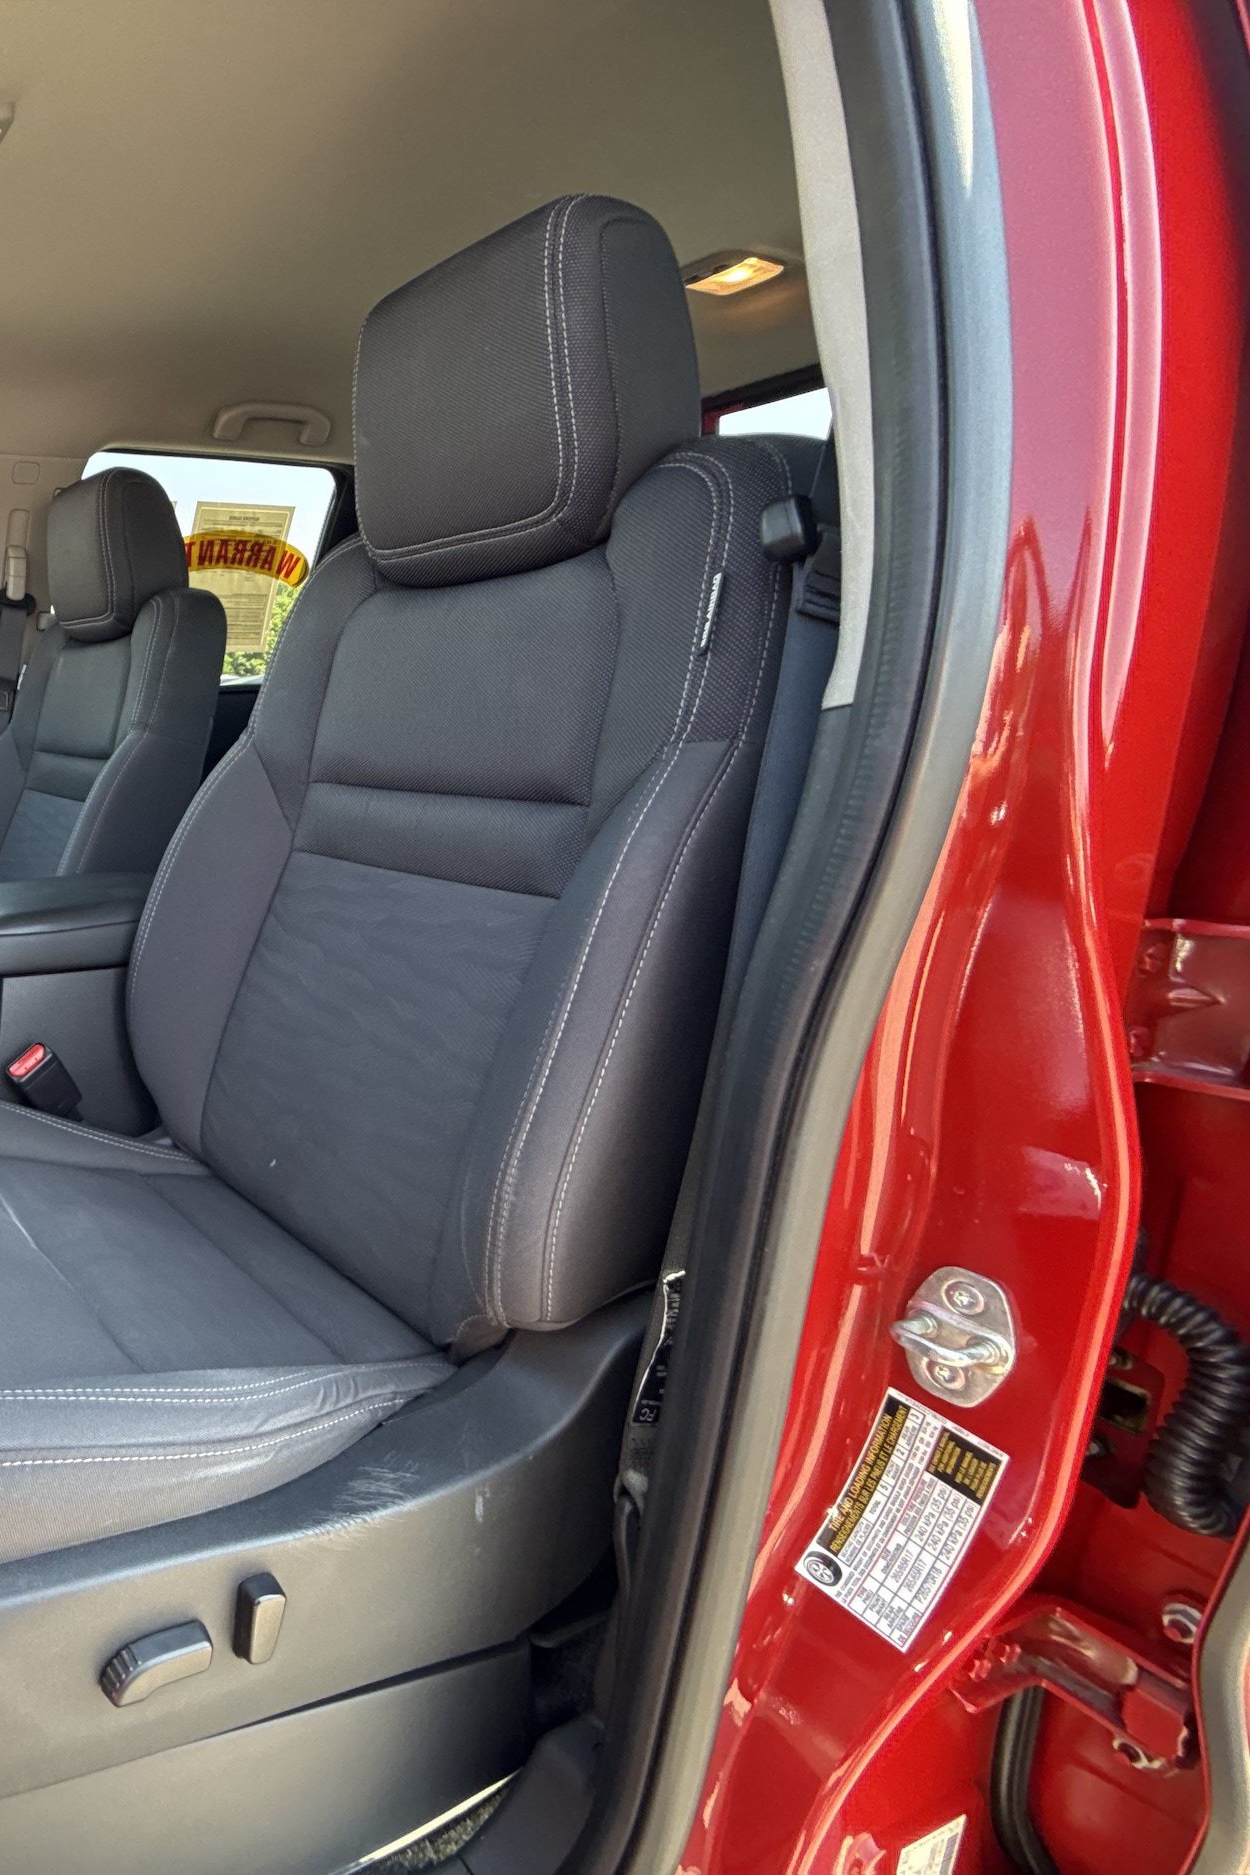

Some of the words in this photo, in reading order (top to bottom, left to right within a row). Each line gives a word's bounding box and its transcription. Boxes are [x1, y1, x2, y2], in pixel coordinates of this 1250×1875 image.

[885, 1404, 907, 1445] CHARGEMENT
[878, 1450, 888, 1460] ET
[882, 1442, 892, 1453] LE
[827, 1511, 845, 1532] TIRE
[837, 1495, 854, 1515] AND
[847, 1462, 871, 1498] LOADING
[864, 1413, 892, 1465] INFORMATION
[870, 1458, 884, 1480] PNEUS
[864, 1476, 876, 1492] LES
[857, 1488, 871, 1504] SUR
[914, 1524, 928, 1542] 240
[921, 1510, 935, 1527] kPa
[928, 1496, 942, 1512] (35
[927, 1533, 942, 1551] 240
[935, 1518, 949, 1536] kPa
[942, 1505, 956, 1521] (35
[940, 1542, 955, 1560] 240
